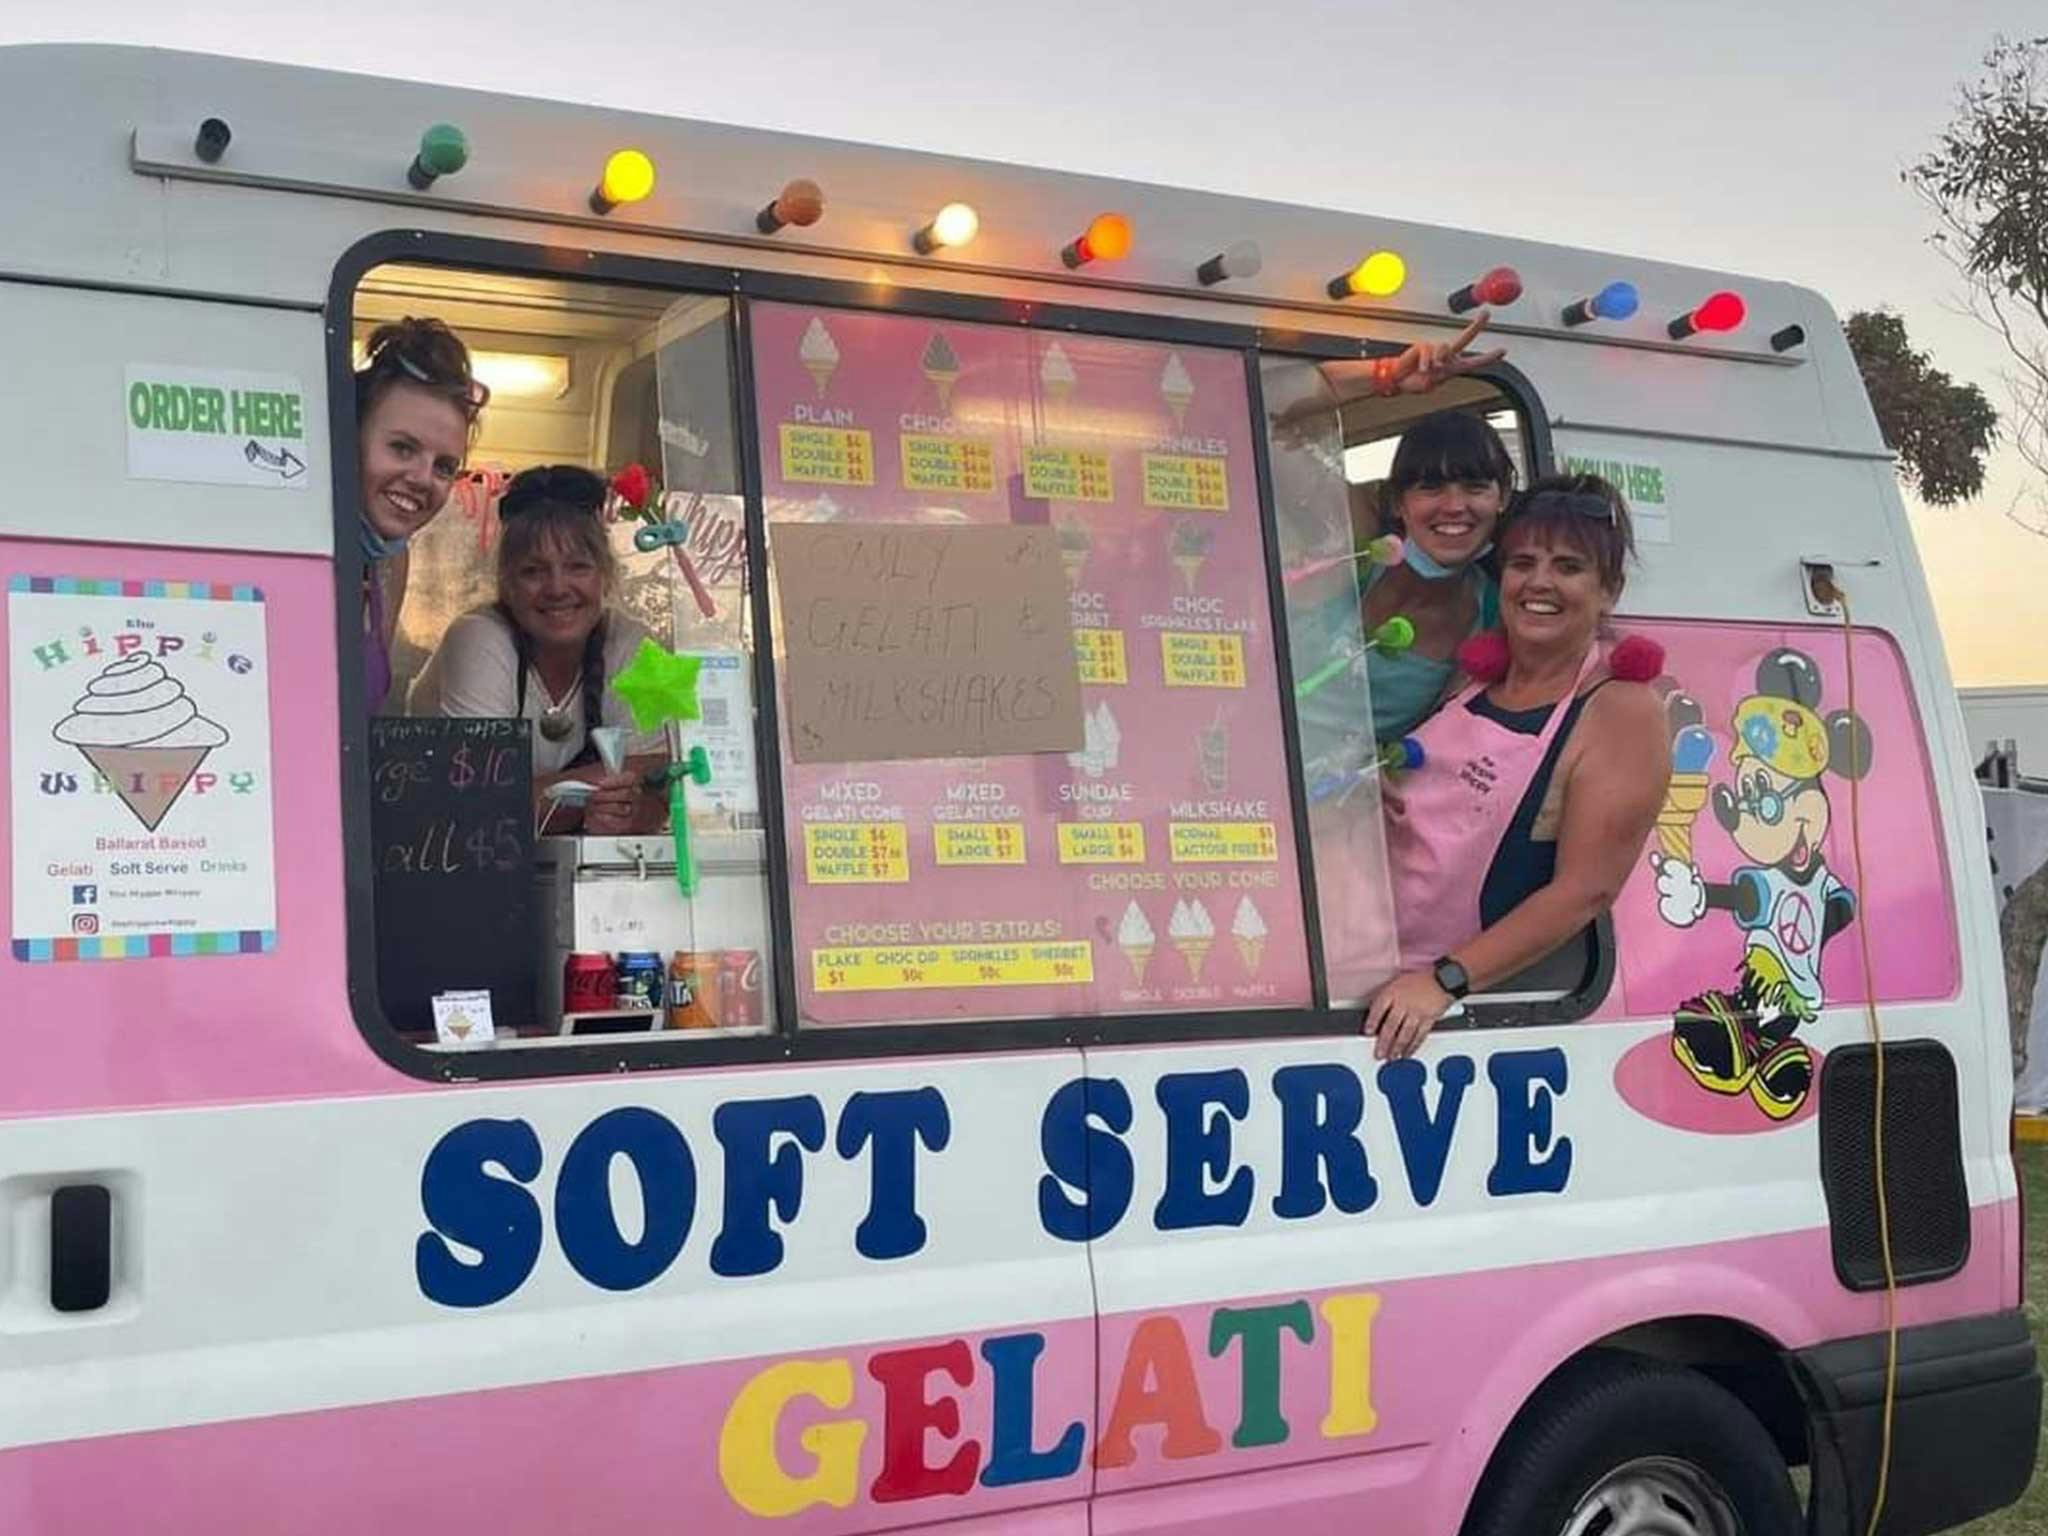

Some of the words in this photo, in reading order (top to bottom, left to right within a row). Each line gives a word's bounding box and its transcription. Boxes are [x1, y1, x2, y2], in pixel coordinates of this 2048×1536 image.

[129, 381, 226, 434] ORDER
[232, 390, 303, 439] HERE
[795, 404, 853, 428] PLAIN
[790, 447, 842, 462] DOUBLE
[909, 457, 960, 471] DOUBLE
[1030, 464, 1076, 479] DOUBLE
[792, 464, 842, 480] WAFFLE
[911, 472, 960, 487] WAFFLE
[1031, 481, 1076, 495] WAFFLE
[1148, 475, 1192, 488] DOUBLE
[1626, 463, 1665, 503] HERE
[1152, 489, 1193, 503] WAFFLE
[1068, 593, 1104, 610] HOC
[1173, 596, 1223, 614] CHOC
[808, 598, 979, 653] GELATI
[1170, 653, 1216, 666] DOUBLE
[1173, 668, 1217, 681] WAFFLE
[821, 672, 1057, 736] MILKSHAKES
[819, 782, 881, 801] MIXED
[946, 783, 1005, 802] MIXED
[1058, 783, 1134, 801] SUNDAE
[801, 804, 857, 821] GELATI
[860, 805, 904, 820] CONE
[933, 805, 987, 821] GELATI
[991, 805, 1021, 819] CUP
[1081, 804, 1112, 819] CUP
[1170, 800, 1267, 818] MILKSHAKE
[814, 828, 858, 842] SINGLE
[948, 827, 988, 841] SMALL
[1072, 827, 1112, 840] SMALL
[1174, 826, 1221, 841] NORMAL
[96, 836, 155, 851] Ballarat
[158, 836, 207, 849] Based
[948, 843, 992, 858] LARGE
[1073, 843, 1115, 857] LARGE
[1175, 842, 1228, 857] LACTOSE
[1230, 842, 1258, 856] FREE
[814, 844, 866, 859] DOUBLE
[47, 862, 93, 877] Gelati
[110, 861, 141, 876] Soft
[145, 861, 189, 875] Serve
[200, 859, 248, 873] Drinks
[816, 863, 867, 876] WAFFLE
[1089, 872, 1165, 891] CHOOSE
[1172, 871, 1223, 890] YOUR
[825, 923, 912, 944] CHOOSE
[919, 921, 976, 942] YOUR
[875, 952, 914, 965] CHOC
[917, 950, 940, 964] DIP
[952, 949, 1020, 963] SPRINKLES
[1032, 945, 1087, 960] SHERBET
[818, 953, 862, 968] FLAKE
[828, 971, 845, 985] $1
[415, 1086, 951, 1308] SOFT
[1038, 1047, 1573, 1243] SERVE
[718, 1292, 1381, 1518] GELATI
